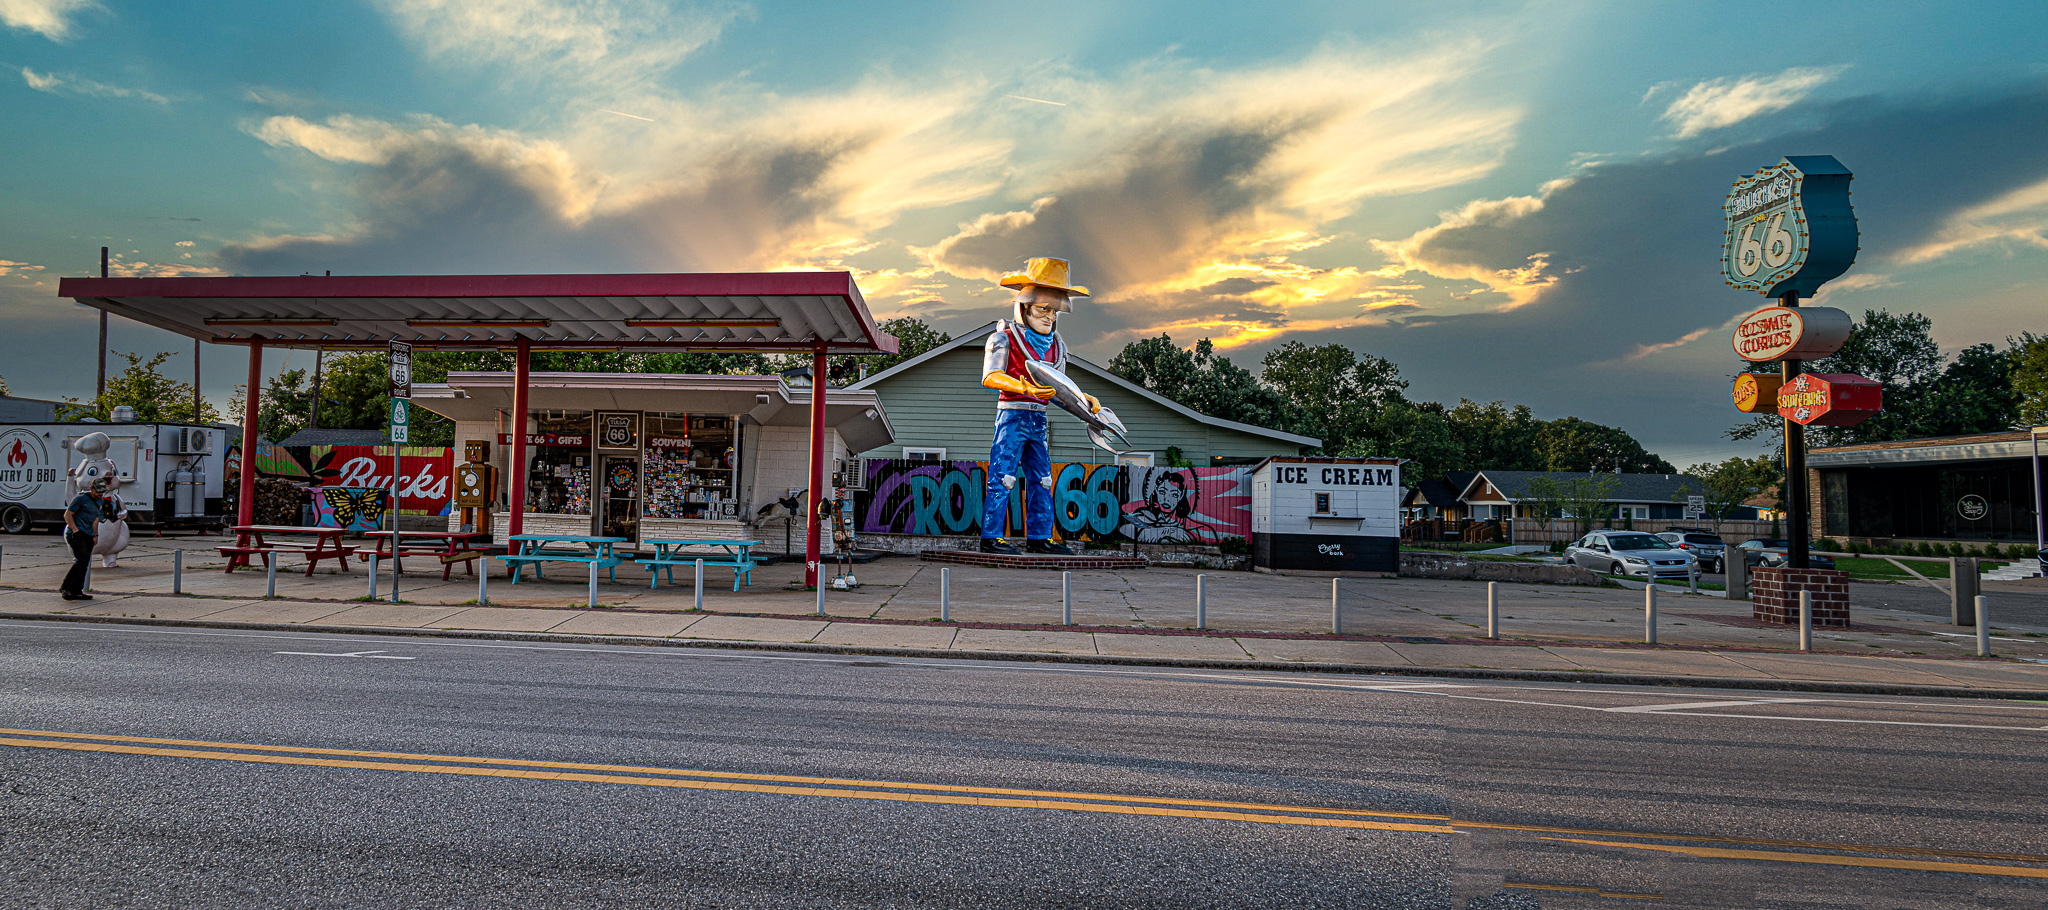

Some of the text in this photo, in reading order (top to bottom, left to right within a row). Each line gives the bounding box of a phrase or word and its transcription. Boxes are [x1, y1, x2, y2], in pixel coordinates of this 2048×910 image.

[1733, 211, 1792, 278] 66
[1738, 314, 1792, 337] COSMIC
[391, 342, 410, 353] HISTORIC
[1739, 331, 1792, 354] CURIOS
[395, 369, 405, 382] 66
[394, 388, 407, 397] ROUTE
[394, 427, 405, 440] 66
[534, 435, 545, 444] 66
[557, 436, 582, 445] GIFTS
[610, 429, 625, 441] 66
[37, 469, 56, 483] BBQ
[339, 457, 449, 499] Bucks
[1276, 467, 1393, 486] ICE CREAM
[1055, 464, 1121, 536] 66
